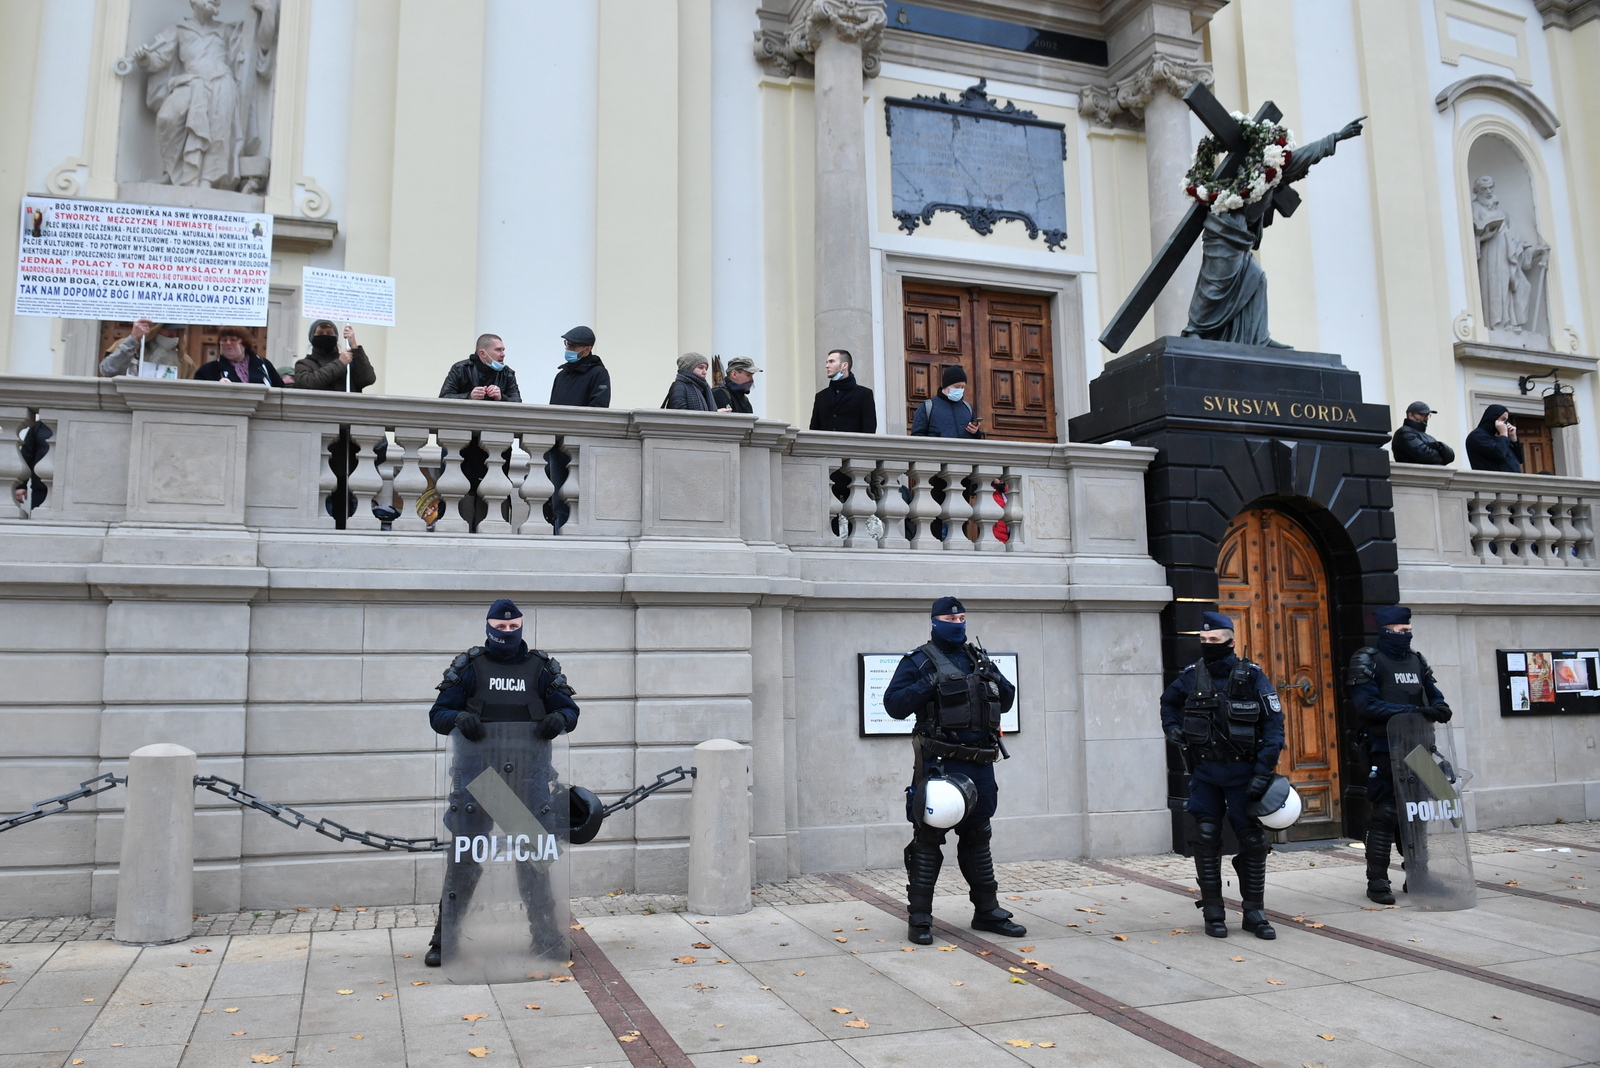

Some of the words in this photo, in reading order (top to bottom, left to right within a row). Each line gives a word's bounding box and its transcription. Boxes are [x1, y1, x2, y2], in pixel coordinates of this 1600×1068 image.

[1034, 39, 1057, 50] 2002
[73, 204, 113, 213] STWORZYŁ
[116, 207, 160, 216] CZŁOWIEKA
[55, 212, 100, 222] STWORZYŁ
[107, 215, 157, 225] MĘŻCZYZNĘ
[167, 220, 212, 230] NIEWIASTĘ
[24, 228, 57, 237] IDOGIA
[133, 236, 168, 244] KULTUROWE
[182, 239, 211, 247] NONSENS,
[61, 223, 80, 231] MĘSKA
[85, 223, 98, 231] PŁEĆ
[100, 224, 121, 232] ŻEŃSKA
[126, 226, 139, 234] PŁEĆ
[141, 228, 178, 236] BIOLOGICZNA
[182, 230, 214, 238] NATURALNA
[219, 232, 248, 241] NORMALNA
[22, 247, 50, 255] NIEKTÓRE
[75, 250, 116, 259] SPOŁECZNOŚCI
[118, 252, 145, 260] ŚWIATOWE
[174, 256, 197, 264] OGŁUPIĆ
[199, 258, 236, 266] GENDEROWYM
[44, 239, 84, 248] KULTUROWE
[133, 244, 164, 253] MYŚLOWE
[166, 246, 194, 255] MÓZGÓW
[196, 248, 247, 258] POZBAWIONYCH
[20, 256, 62, 265] JEDNAK
[72, 259, 112, 268] POLACY
[138, 262, 173, 271] NARÓD
[176, 265, 223, 275] MYŚLĄCY
[234, 269, 267, 277] MĄDRY
[21, 265, 54, 274] MĄDROŚCIĄ
[72, 268, 98, 277] PŁYNĄCĄ
[136, 272, 160, 280] POZWOLI
[162, 273, 171, 281] SIĘ
[23, 275, 66, 283] WROGOM
[70, 277, 99, 285] BOGA,
[103, 279, 161, 289] CZŁOWIEKA,
[164, 282, 203, 290] NARODU
[213, 285, 264, 293] OJCZYZNY.
[312, 271, 347, 280] EKSPIACJA
[352, 276, 386, 284] PUBLICZNA
[20, 284, 37, 294] TAK
[40, 285, 60, 295] NAM
[63, 286, 107, 298] DOPOMÓŻ
[111, 286, 129, 299] BÓG
[132, 291, 134, 299] I
[138, 291, 173, 301] MARYJA
[176, 291, 220, 304] KRÓLOWA
[223, 296, 254, 305] POLSKI
[1204, 395, 1281, 416] SVRSVM
[1290, 403, 1357, 422] CORDA
[489, 678, 526, 691] POLICJA
[1394, 673, 1420, 684] POLICJA
[1232, 702, 1256, 710] POLICJA
[1406, 799, 1463, 822] POLICJA
[455, 834, 559, 863] POLICJA
